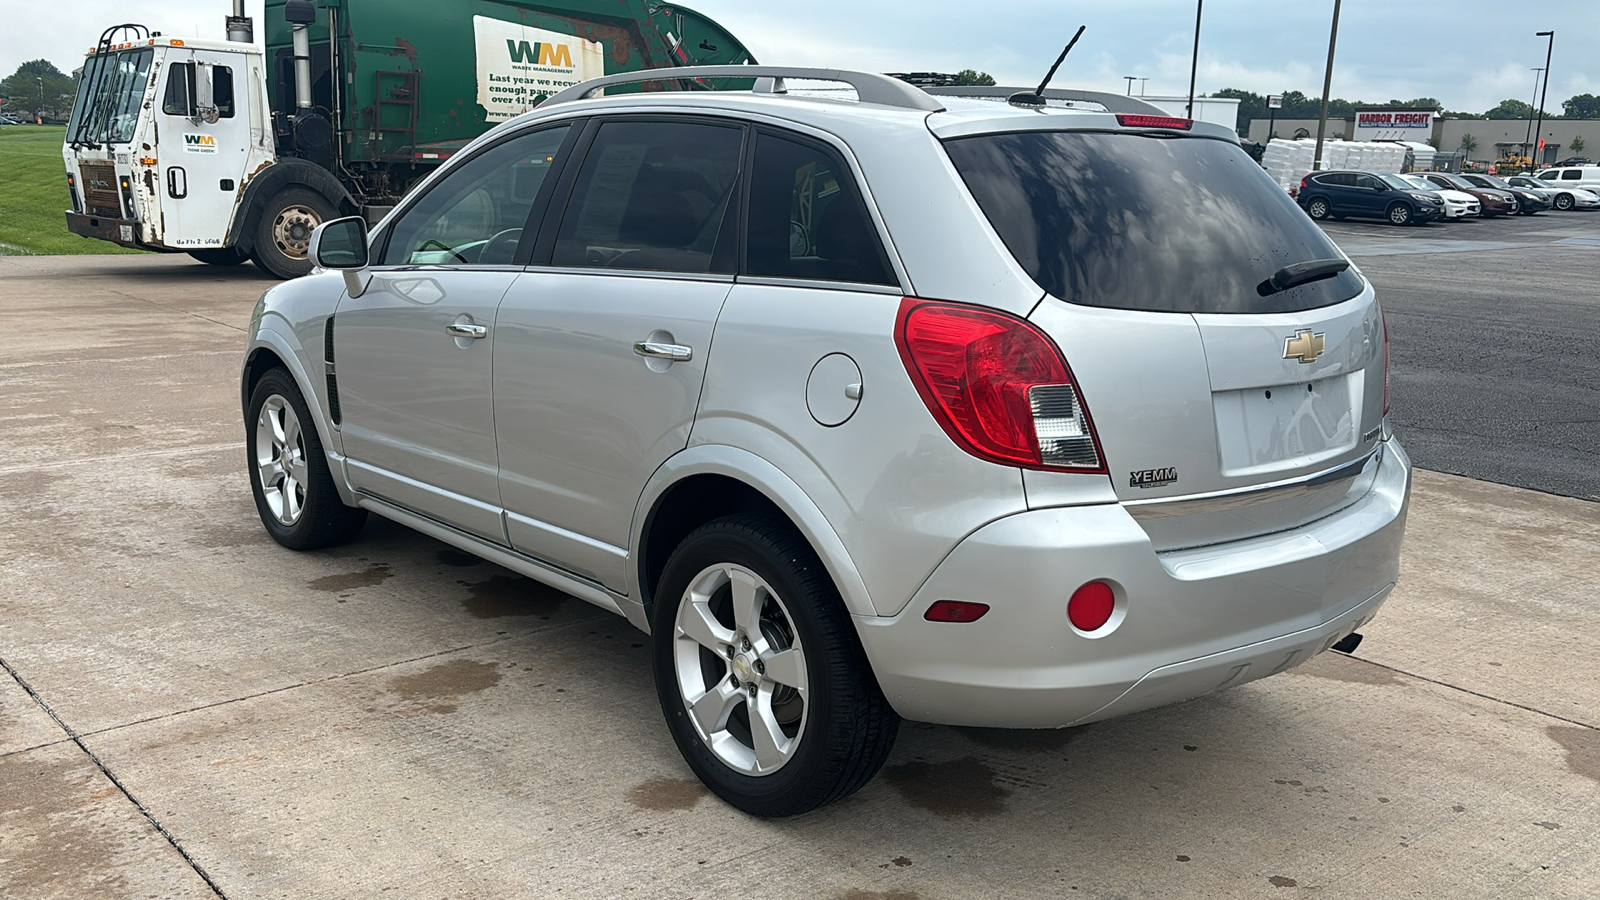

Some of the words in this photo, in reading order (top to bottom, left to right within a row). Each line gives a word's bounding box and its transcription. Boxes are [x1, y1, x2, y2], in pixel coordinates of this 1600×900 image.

[506, 38, 573, 67] WM
[532, 66, 574, 74] MANAGEMENT
[489, 73, 511, 82] Last
[512, 77, 535, 85] year
[489, 86, 527, 96] enough
[529, 89, 559, 97] paper
[491, 96, 514, 104] over
[515, 96, 526, 105] 41
[1358, 113, 1392, 123] HARBOR
[1393, 113, 1430, 123] FREIGHT
[184, 134, 215, 145] WM
[1132, 467, 1177, 483] YEMM
